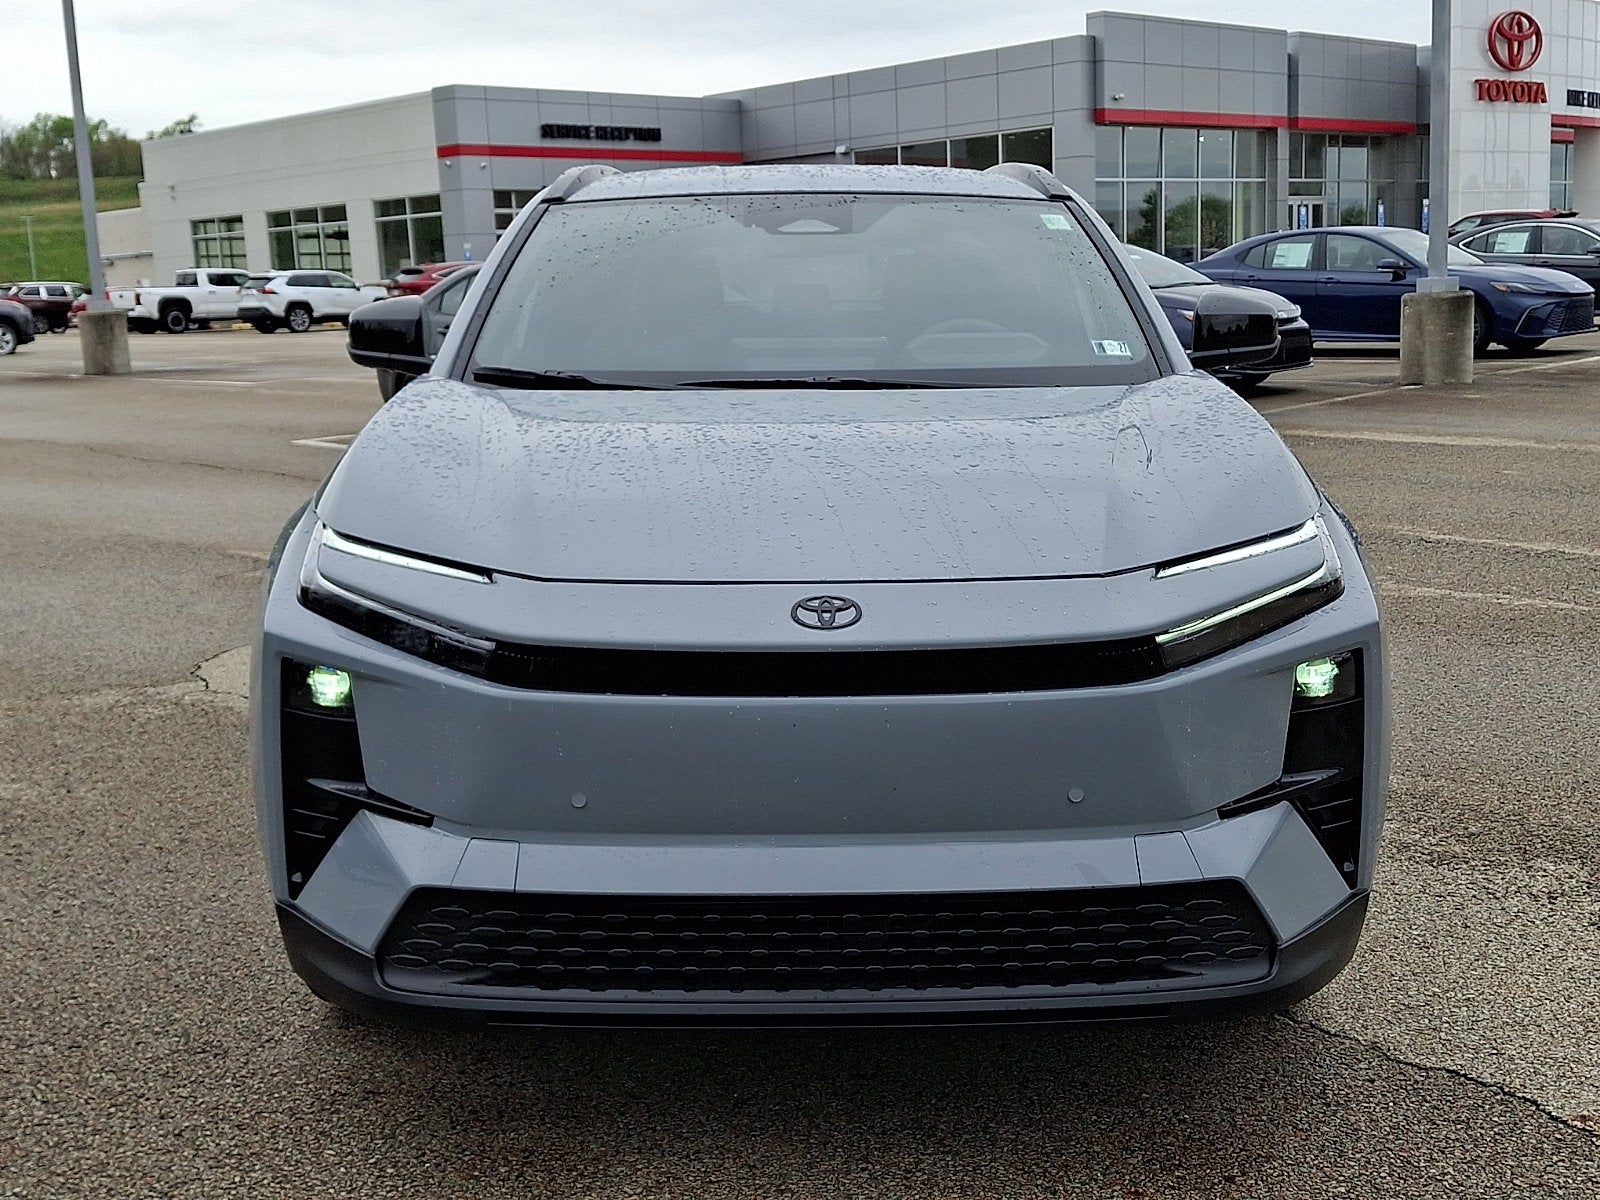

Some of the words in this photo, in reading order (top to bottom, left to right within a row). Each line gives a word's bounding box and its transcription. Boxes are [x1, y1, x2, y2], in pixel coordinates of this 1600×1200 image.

[1475, 79, 1547, 103] TOYOTA
[541, 124, 593, 139] SERVICE
[595, 126, 661, 142] RECEPTION
